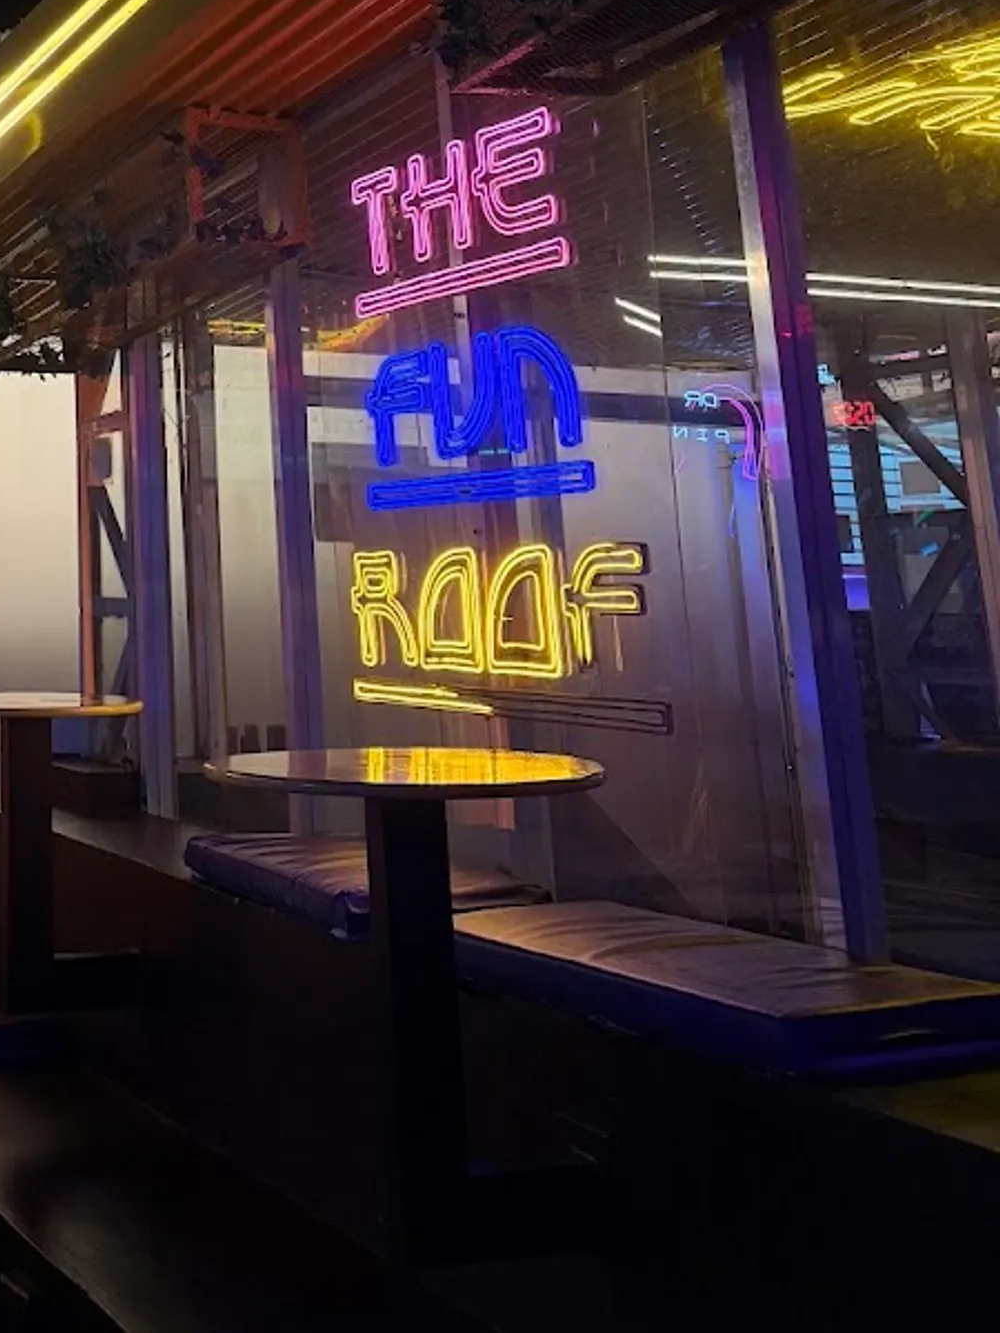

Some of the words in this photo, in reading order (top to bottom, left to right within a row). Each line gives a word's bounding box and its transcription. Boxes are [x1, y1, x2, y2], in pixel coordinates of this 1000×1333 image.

[352, 106, 561, 276] THE
[367, 325, 583, 465] FUN
[352, 543, 649, 678] ROOF
